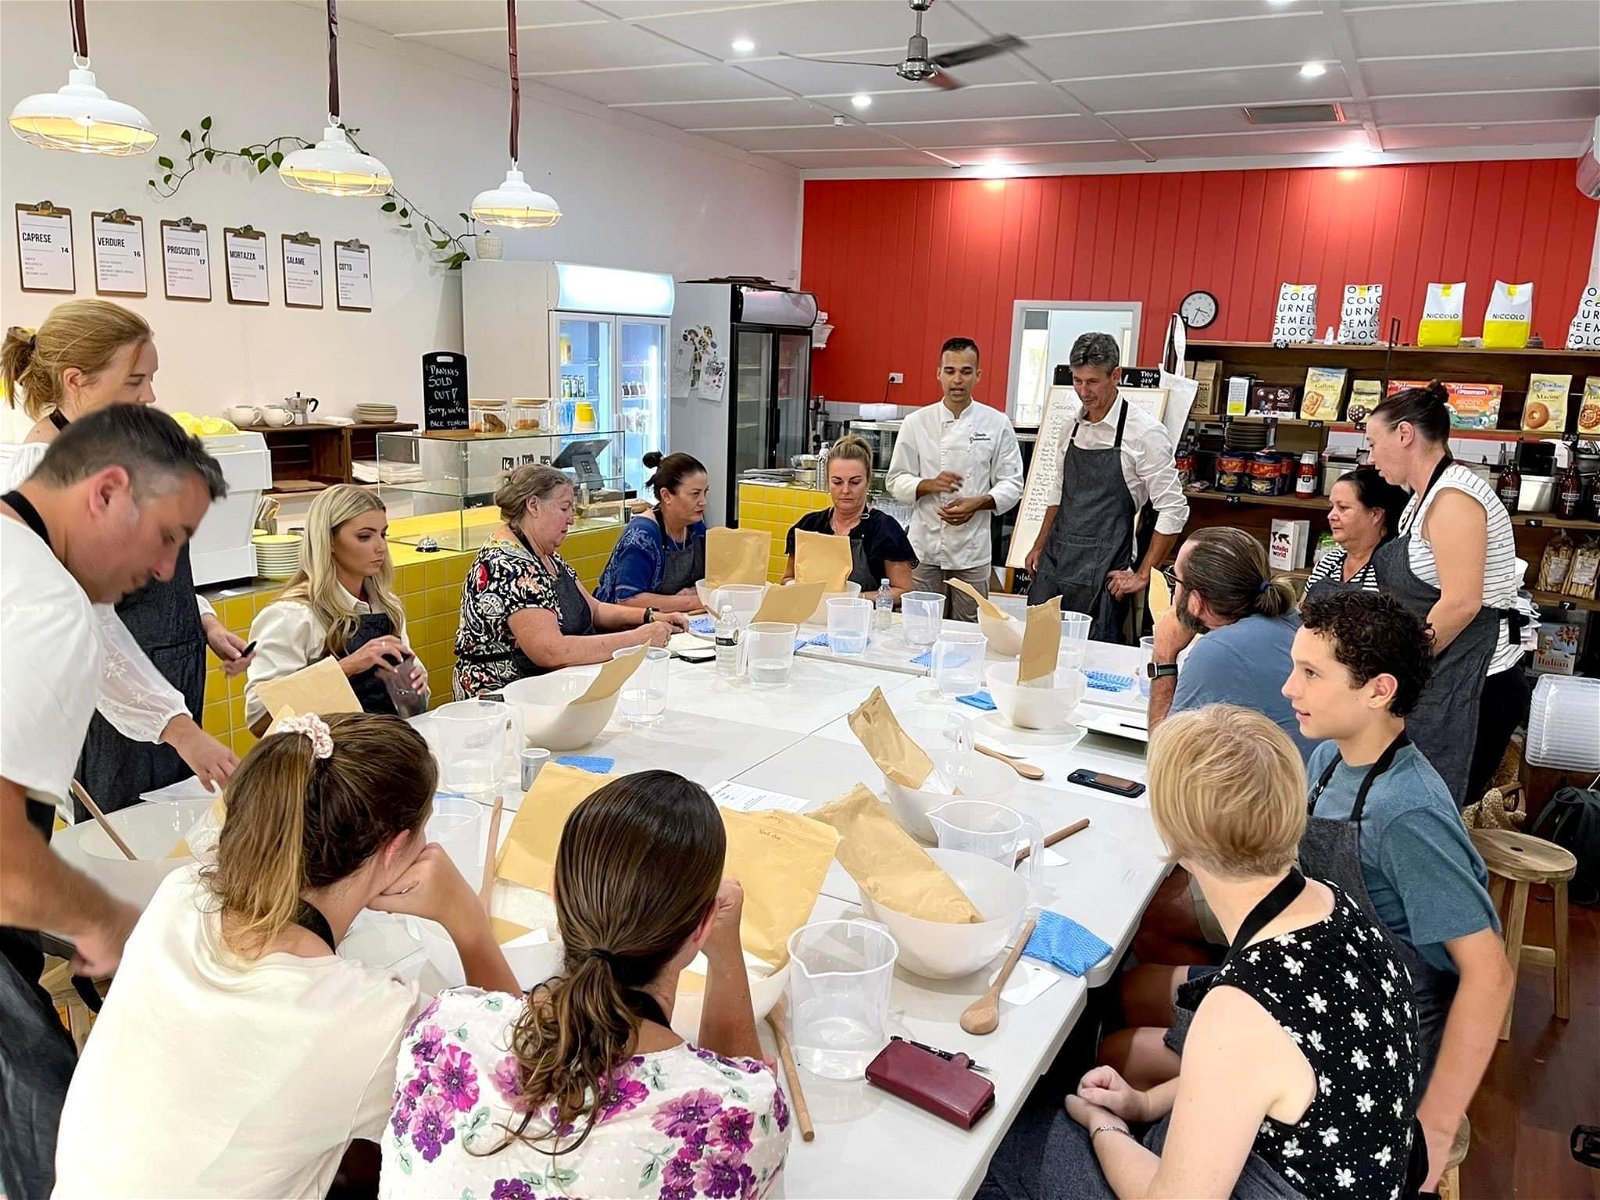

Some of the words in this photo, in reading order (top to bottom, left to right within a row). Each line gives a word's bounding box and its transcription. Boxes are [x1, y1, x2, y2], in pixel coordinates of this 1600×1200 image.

[22, 232, 52, 244] CAPRESE
[97, 237, 126, 248] VERDURE
[167, 245, 201, 257] PROSCIUTTO
[229, 250, 256, 260] MORTAZZA
[286, 256, 305, 266] SALAME
[339, 263, 352, 271] COTTO
[1492, 313, 1525, 321] NICCOLO
[428, 375, 453, 388] SOLD
[1538, 657, 1569, 667] Italian
